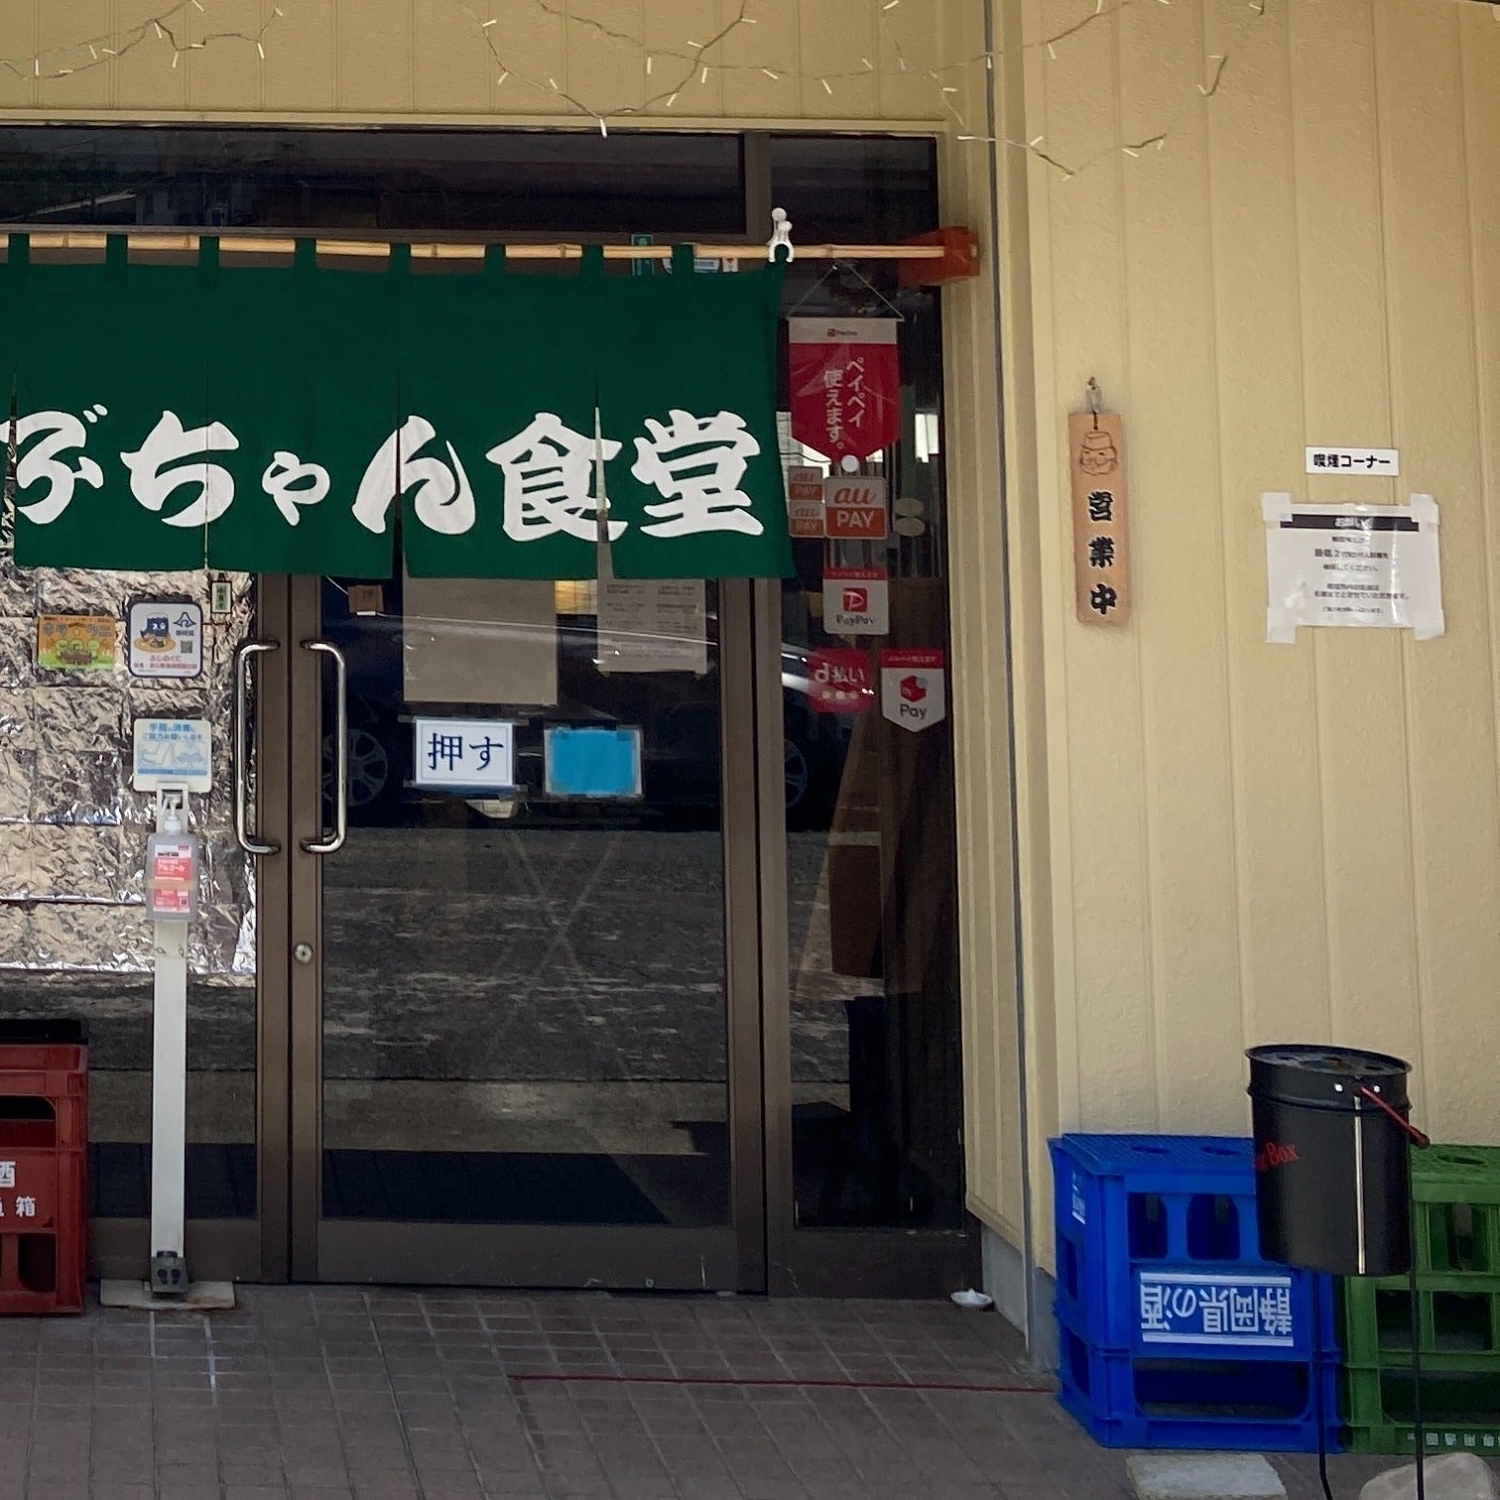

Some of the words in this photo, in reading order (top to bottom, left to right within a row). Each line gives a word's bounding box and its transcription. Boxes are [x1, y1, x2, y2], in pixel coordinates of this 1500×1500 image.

[846, 357, 866, 428] ペイペイ
[824, 369, 845, 450] 使えます。
[1313, 453, 1391, 469] 喫煙コーナー
[834, 488, 876, 504] au
[836, 510, 875, 528] PAY
[1088, 490, 1118, 615] 営業中
[836, 614, 875, 627] PayPay
[900, 703, 927, 719] Pay
[427, 732, 504, 771] 押す
[1141, 1284, 1293, 1335] 静岡県の酒
